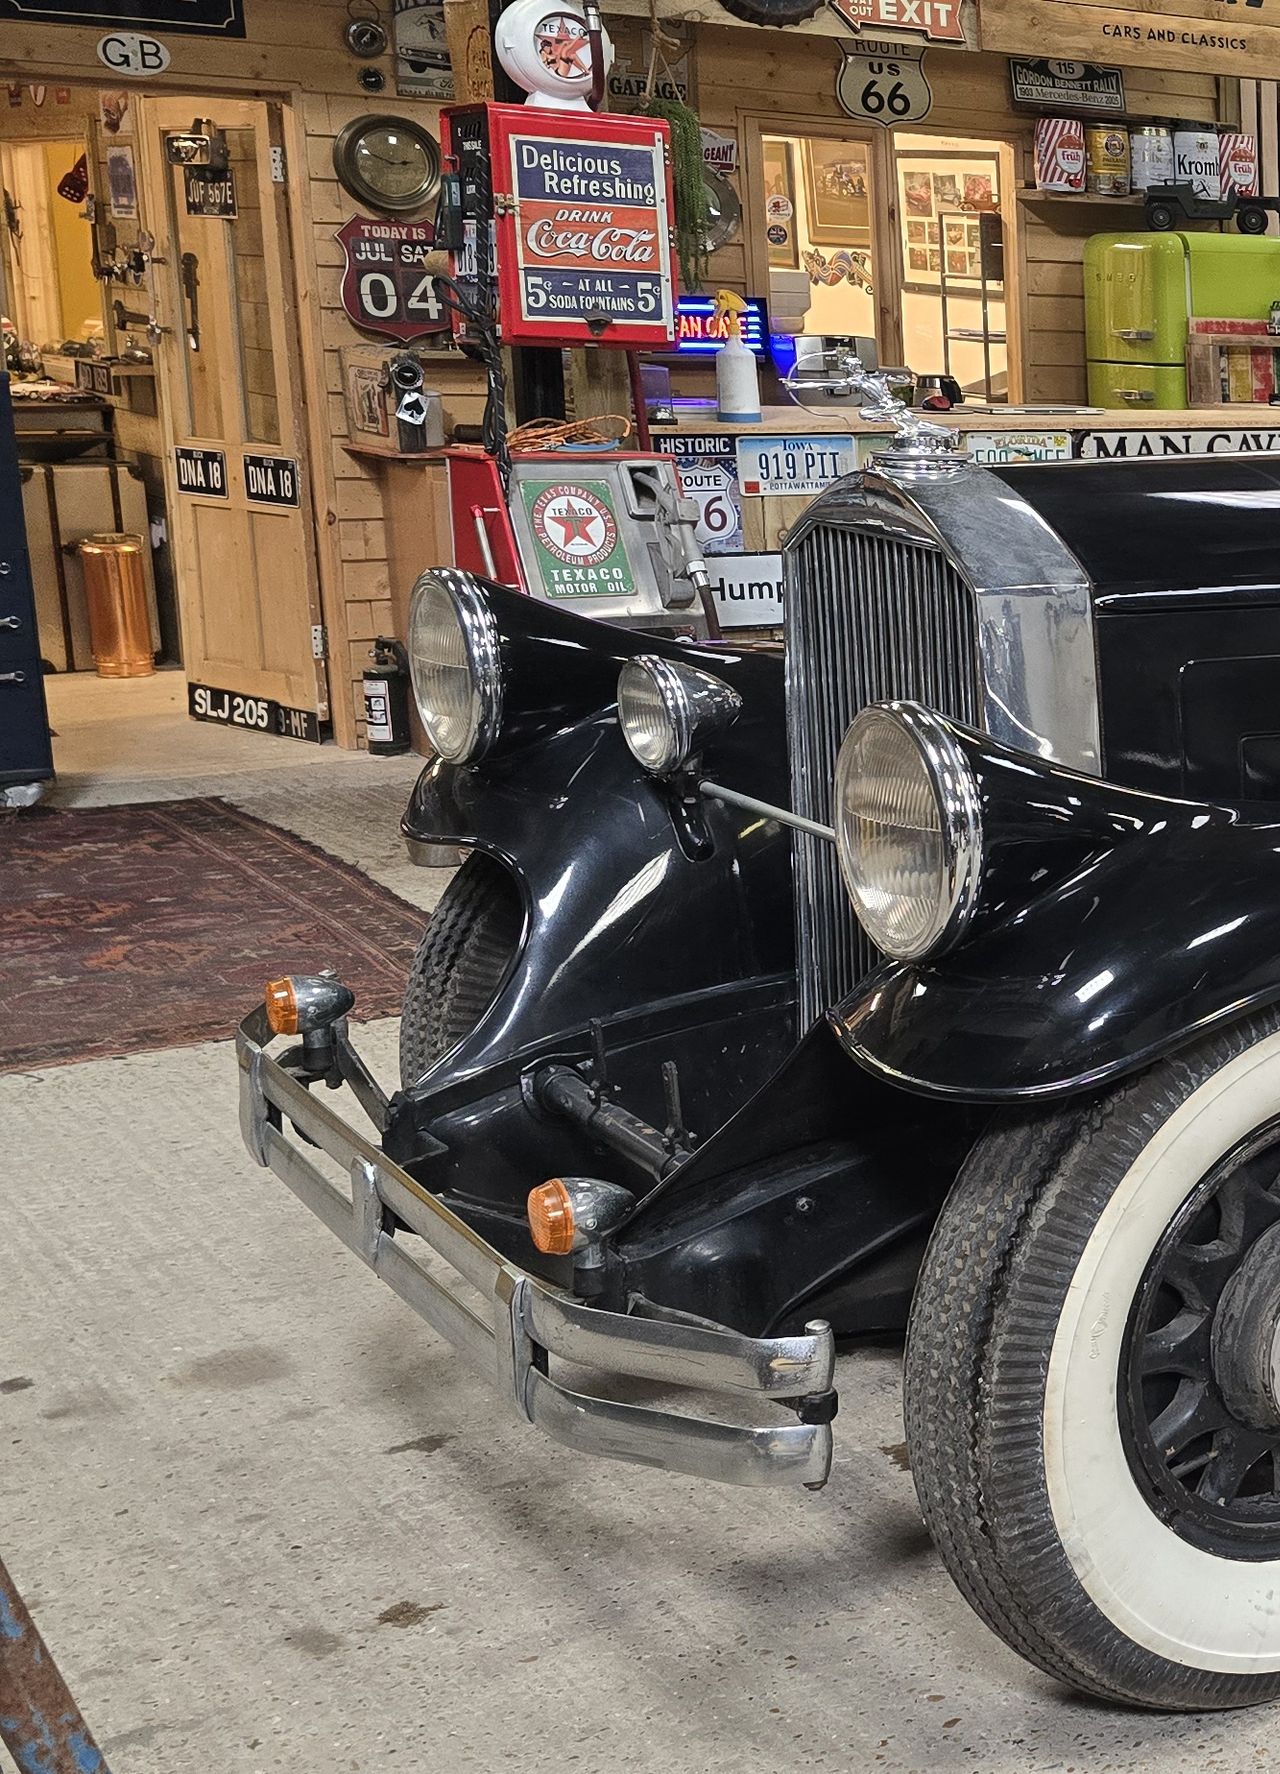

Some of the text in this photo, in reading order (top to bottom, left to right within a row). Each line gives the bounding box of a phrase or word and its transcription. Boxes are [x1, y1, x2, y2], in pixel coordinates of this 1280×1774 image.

[849, 6, 873, 17] OUT
[879, 0, 952, 27] EXIT
[542, 23, 587, 37] TEXACO
[1102, 24, 1247, 50] CARS AND CLASSICS
[102, 37, 163, 70] GB
[855, 40, 911, 56] ROUTE
[868, 61, 901, 76] US
[1055, 61, 1076, 75] 115
[609, 77, 687, 101] GARAGE
[1016, 65, 1118, 95] GORDON BENNETT RALLY
[861, 79, 911, 116] 66
[1035, 88, 1103, 104] Mercedes-Benz
[522, 145, 622, 175] Delicious
[704, 143, 735, 162] GEANT
[208, 182, 233, 204] 567E
[544, 171, 655, 205] Refreshing
[555, 209, 614, 223] DRINK
[361, 225, 426, 240] TODAY IS
[355, 242, 394, 262] JUL
[578, 278, 591, 291] AT
[595, 279, 614, 293] ALL
[549, 294, 635, 312] SODA FOUNTAINS
[679, 315, 701, 338] AN
[660, 437, 730, 454] HISTORIC
[994, 435, 1048, 449] FLORIDA
[1093, 435, 1191, 458] MAN
[180, 458, 222, 489] DNA 18
[758, 453, 797, 480] 919
[248, 465, 293, 498] DNA 18
[552, 507, 593, 516] TEXACO
[538, 531, 616, 566] PETROLEUM PRODUCTS
[551, 567, 624, 582] TEXACO
[554, 581, 628, 594] MOTOR OIL
[194, 688, 269, 729] SLJ 205
